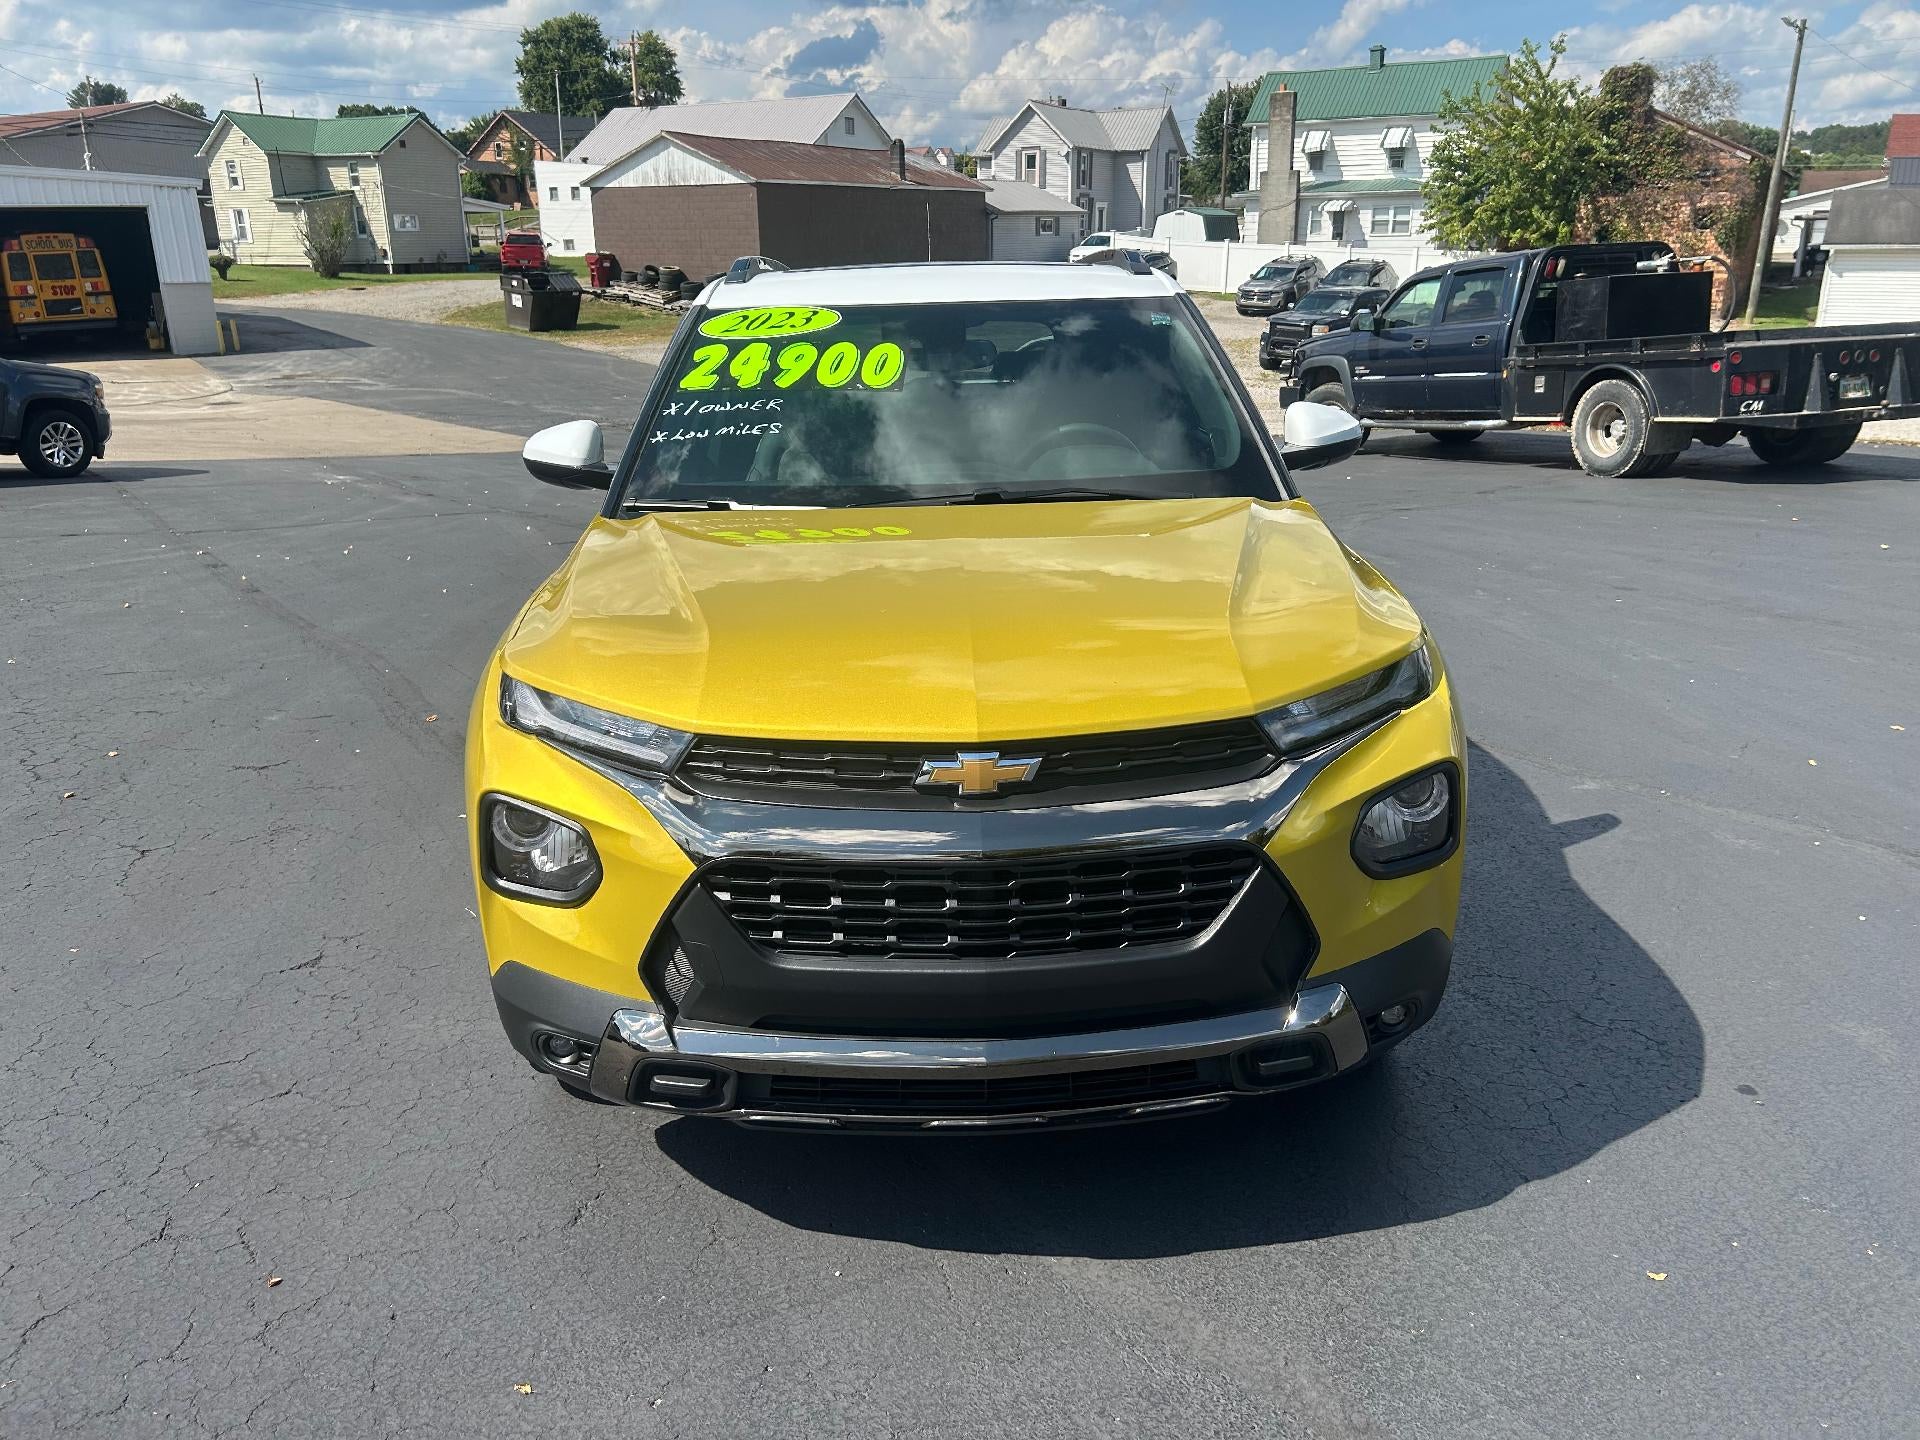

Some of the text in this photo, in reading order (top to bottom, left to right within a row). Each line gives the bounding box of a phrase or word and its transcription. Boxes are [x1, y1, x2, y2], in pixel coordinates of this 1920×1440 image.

[25, 239, 74, 250] SCHOOL BUS
[50, 284, 77, 296] STOP
[719, 310, 819, 334] 2023
[679, 341, 905, 391] 24900
[1739, 399, 1765, 412] CM
